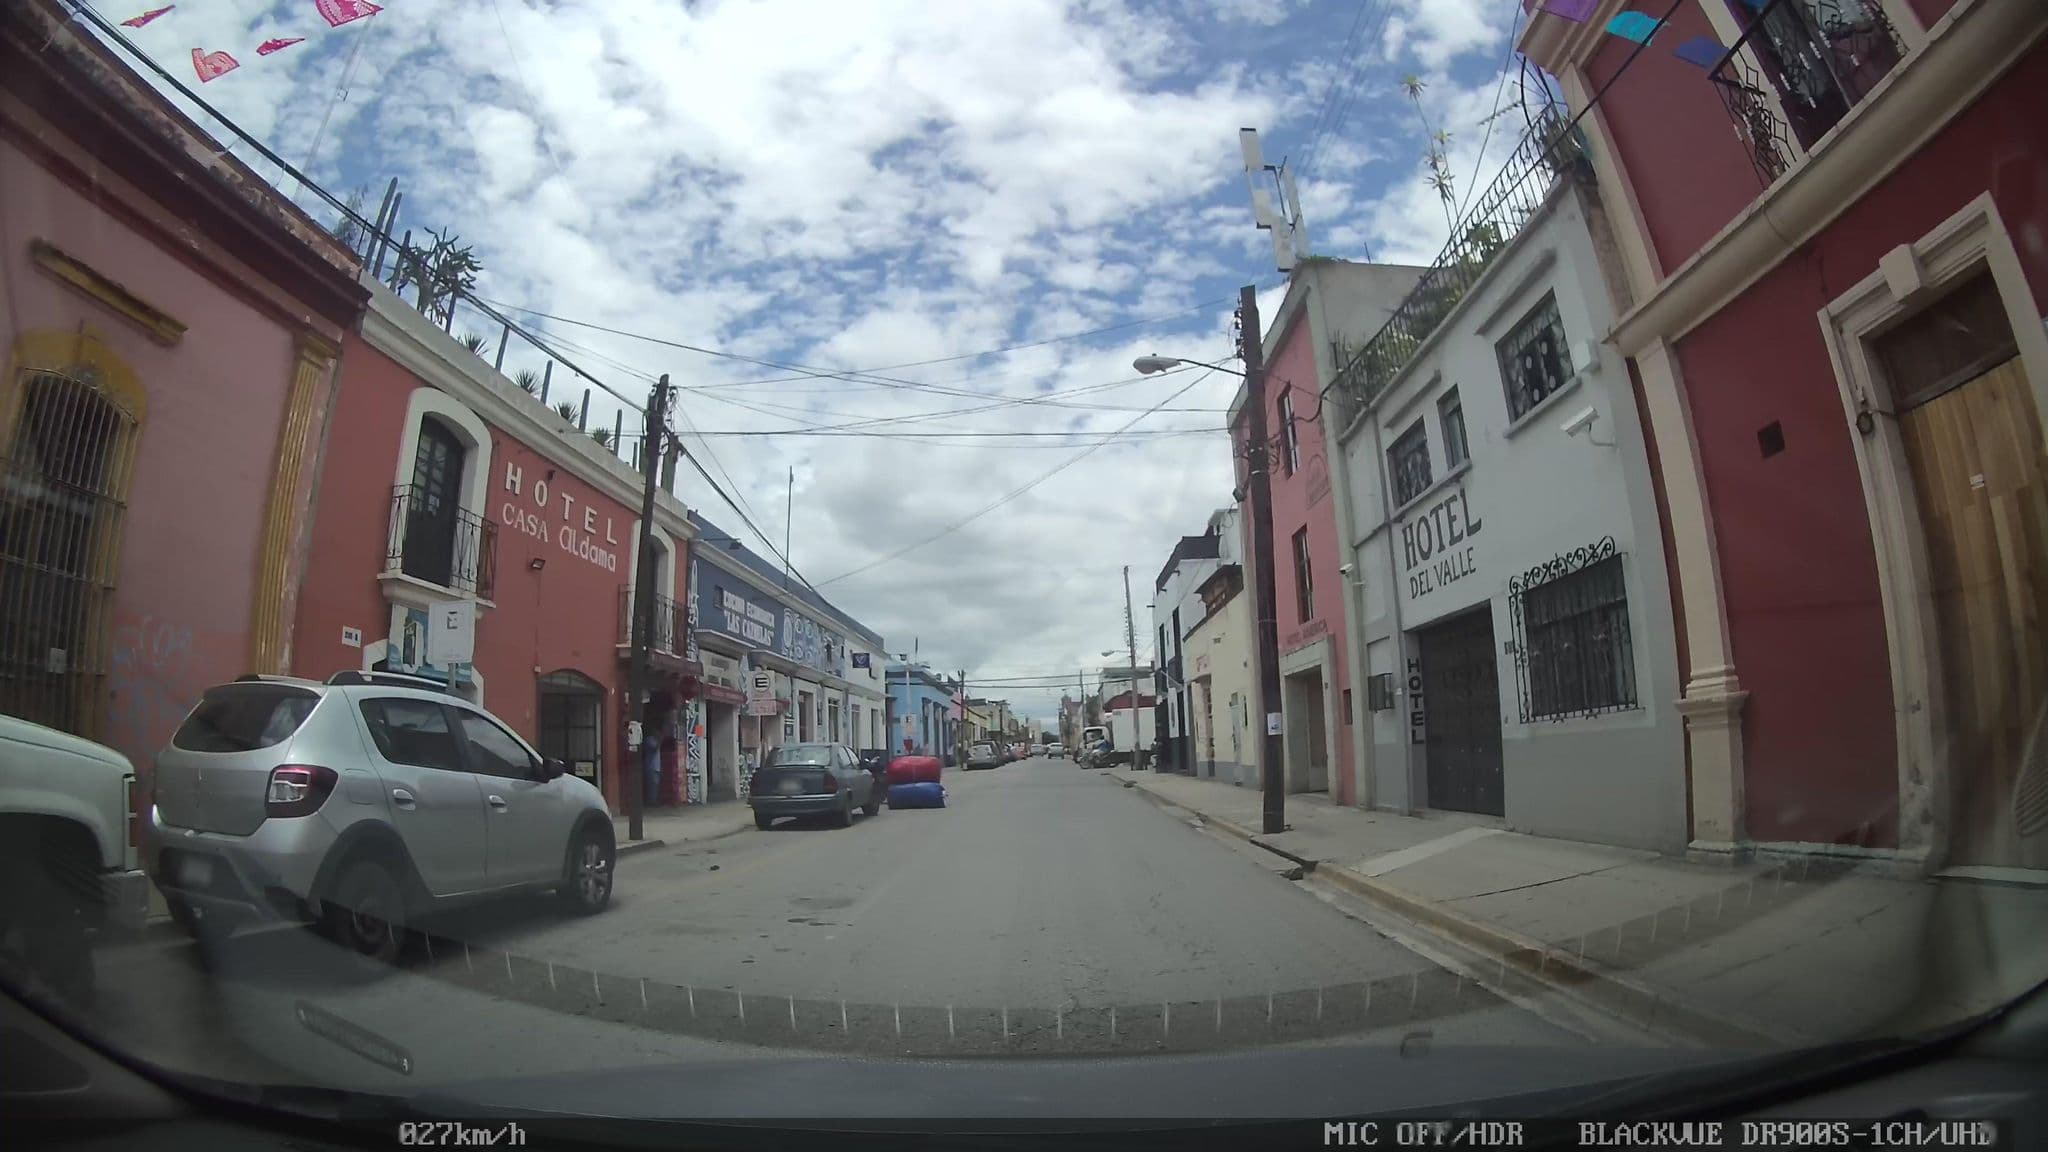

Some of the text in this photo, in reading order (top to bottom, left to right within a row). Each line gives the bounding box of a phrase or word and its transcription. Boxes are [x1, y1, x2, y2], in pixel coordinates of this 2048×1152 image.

[502, 502, 548, 543] CASA
[505, 462, 618, 545] HOTEL
[1402, 487, 1482, 571] HOTEL
[1409, 547, 1477, 600] DEL VALLE
[755, 677, 769, 688] E
[1408, 658, 1425, 745] HOTEL
